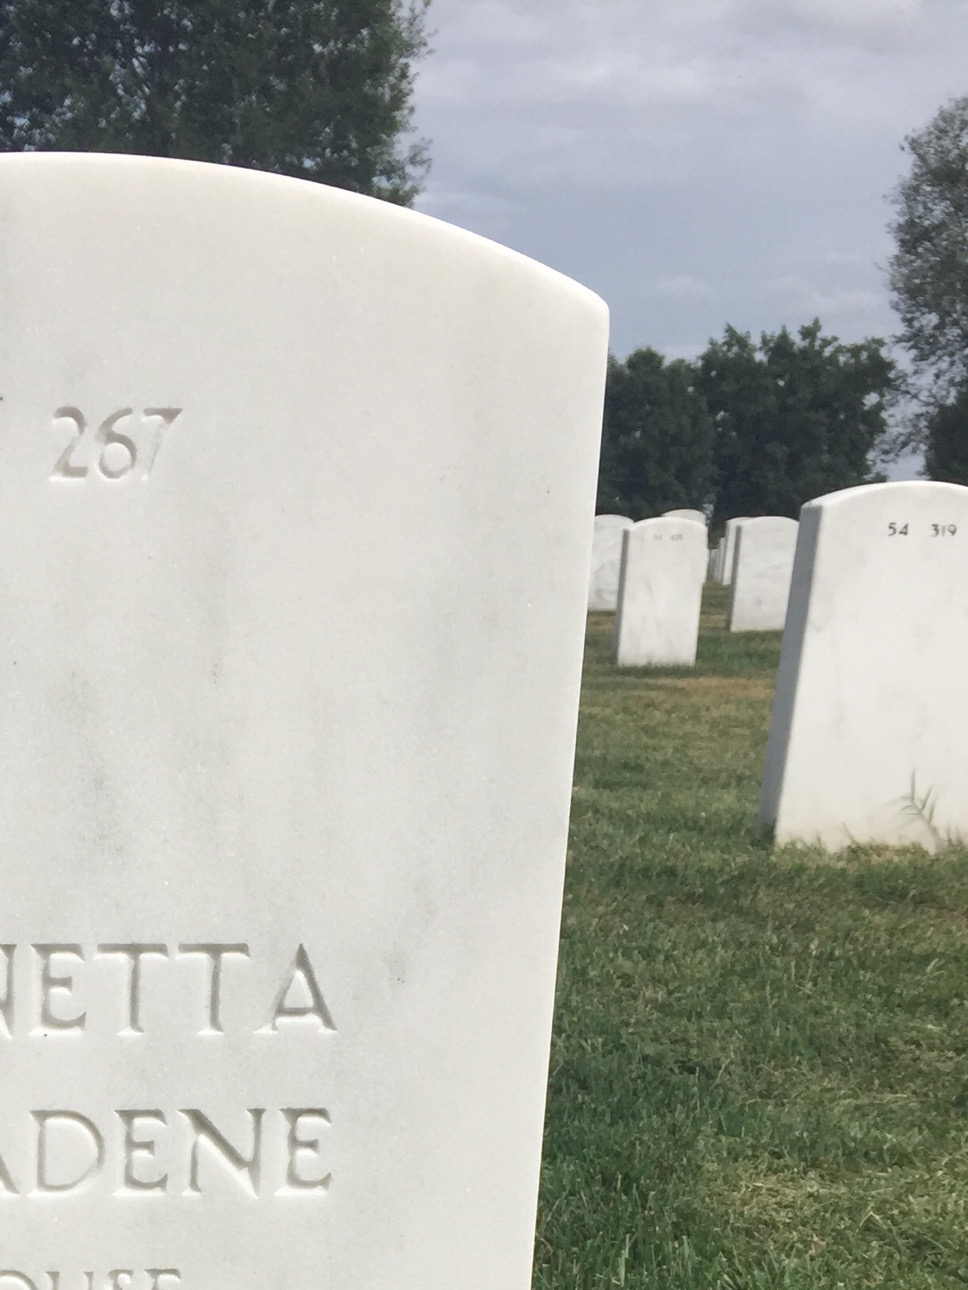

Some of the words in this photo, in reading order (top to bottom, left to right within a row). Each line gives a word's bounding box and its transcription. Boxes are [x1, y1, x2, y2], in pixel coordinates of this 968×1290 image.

[49, 406, 183, 481] 267
[888, 522, 909, 536] 54
[931, 523, 958, 537] 319
